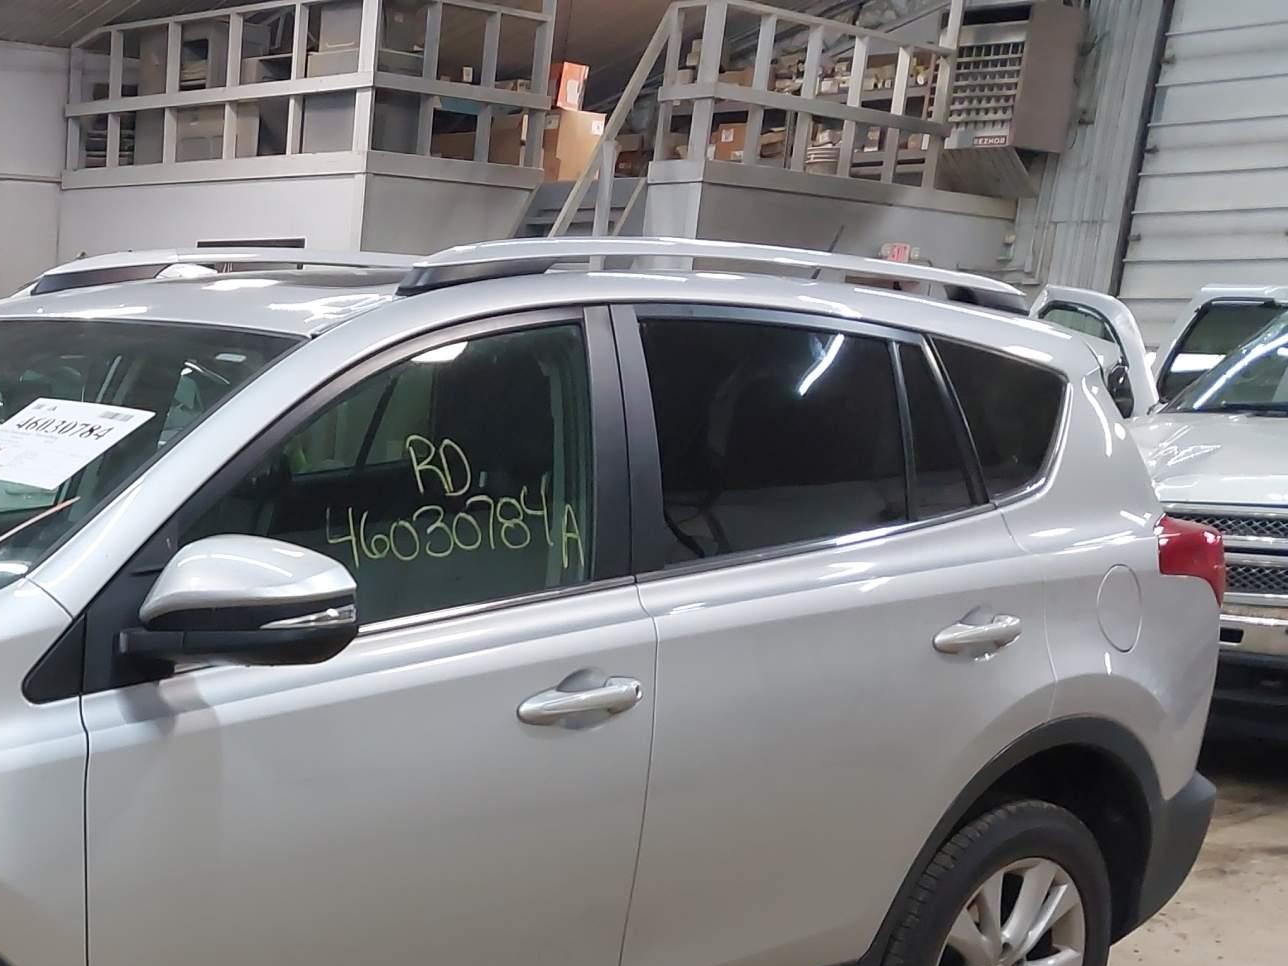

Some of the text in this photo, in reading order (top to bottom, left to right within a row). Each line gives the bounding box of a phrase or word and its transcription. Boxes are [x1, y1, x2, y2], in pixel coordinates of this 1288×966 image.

[16, 416, 114, 440] 46030784
[405, 434, 472, 496] RD
[326, 472, 585, 569] 46030784 A
